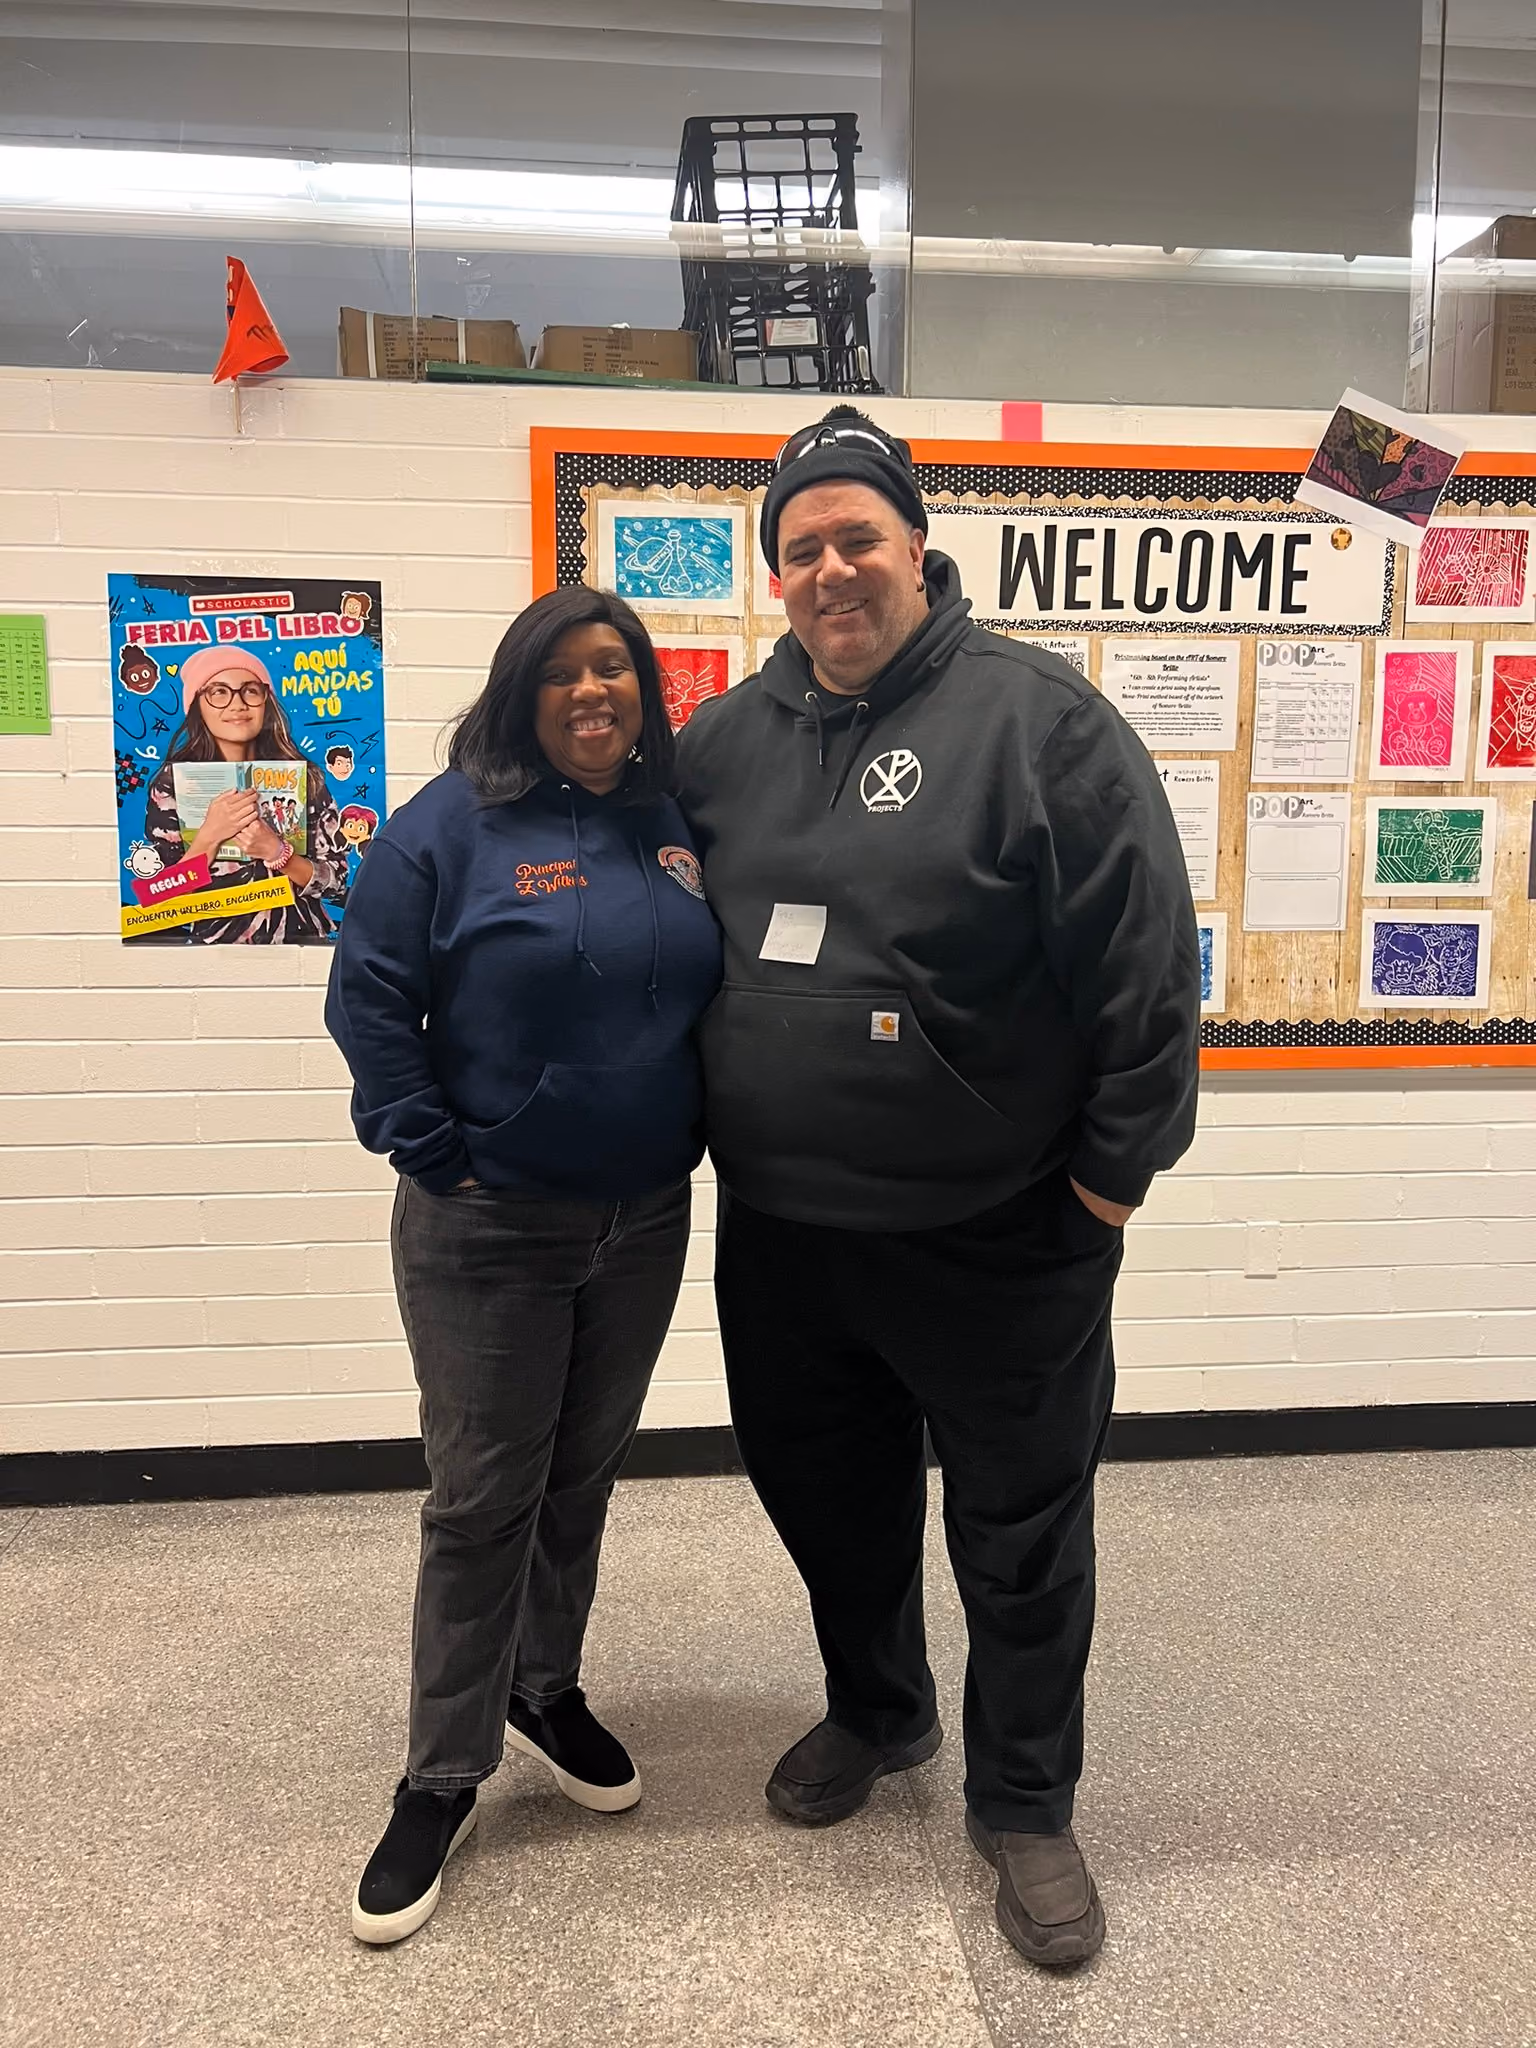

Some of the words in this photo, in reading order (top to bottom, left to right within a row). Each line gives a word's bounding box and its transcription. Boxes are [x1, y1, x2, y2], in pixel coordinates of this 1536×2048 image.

[999, 524, 1311, 614] WELCOME
[207, 597, 288, 609] SCHOLASTIC
[128, 622, 209, 644] FERIA
[218, 618, 269, 640] DEL
[280, 615, 361, 637] LIBRO
[1049, 640, 1077, 649] Artwork
[1261, 644, 1312, 667] POP
[294, 642, 347, 673] AQUÍ
[282, 671, 373, 697] MANDAS
[312, 692, 342, 717] TÚ
[253, 767, 298, 790] PAWS
[867, 805, 903, 813] PROJECTS
[1252, 797, 1300, 818] POP
[516, 859, 576, 880] Principal
[149, 873, 187, 894] REGLA
[188, 870, 198, 881] 1:
[515, 880, 538, 896] Z
[126, 908, 178, 926] ENCUENTRA
[180, 906, 192, 915] UN
[226, 887, 287, 906] ENCUÉNTRATE
